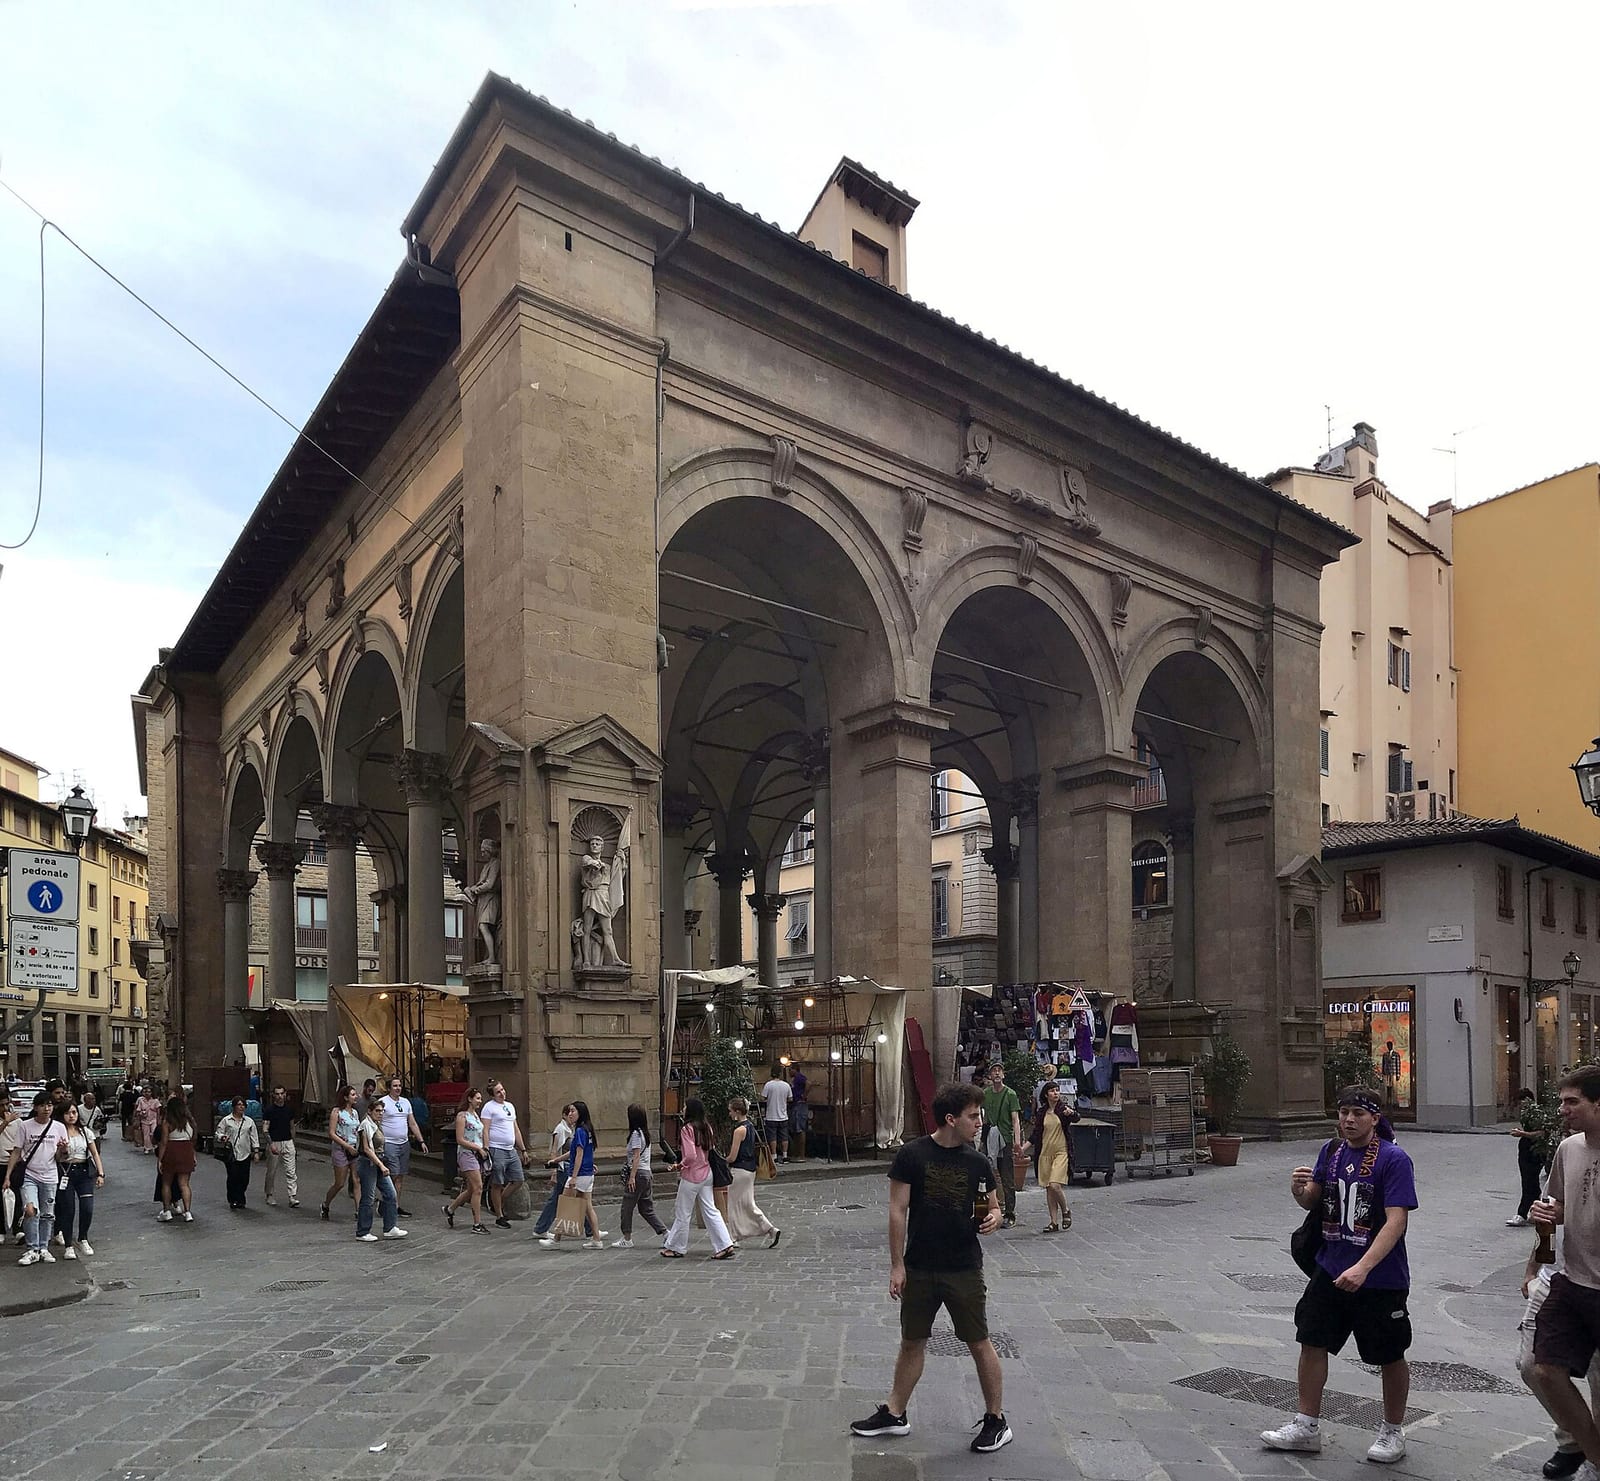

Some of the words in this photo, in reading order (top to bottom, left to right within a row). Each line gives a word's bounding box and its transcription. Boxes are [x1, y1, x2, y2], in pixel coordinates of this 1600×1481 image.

[34, 857, 57, 866] area
[22, 867, 69, 879] pedonale
[32, 924, 59, 932] eccetto
[1329, 1002, 1360, 1014] EREDI
[1363, 1001, 1410, 1013] CHIARINI
